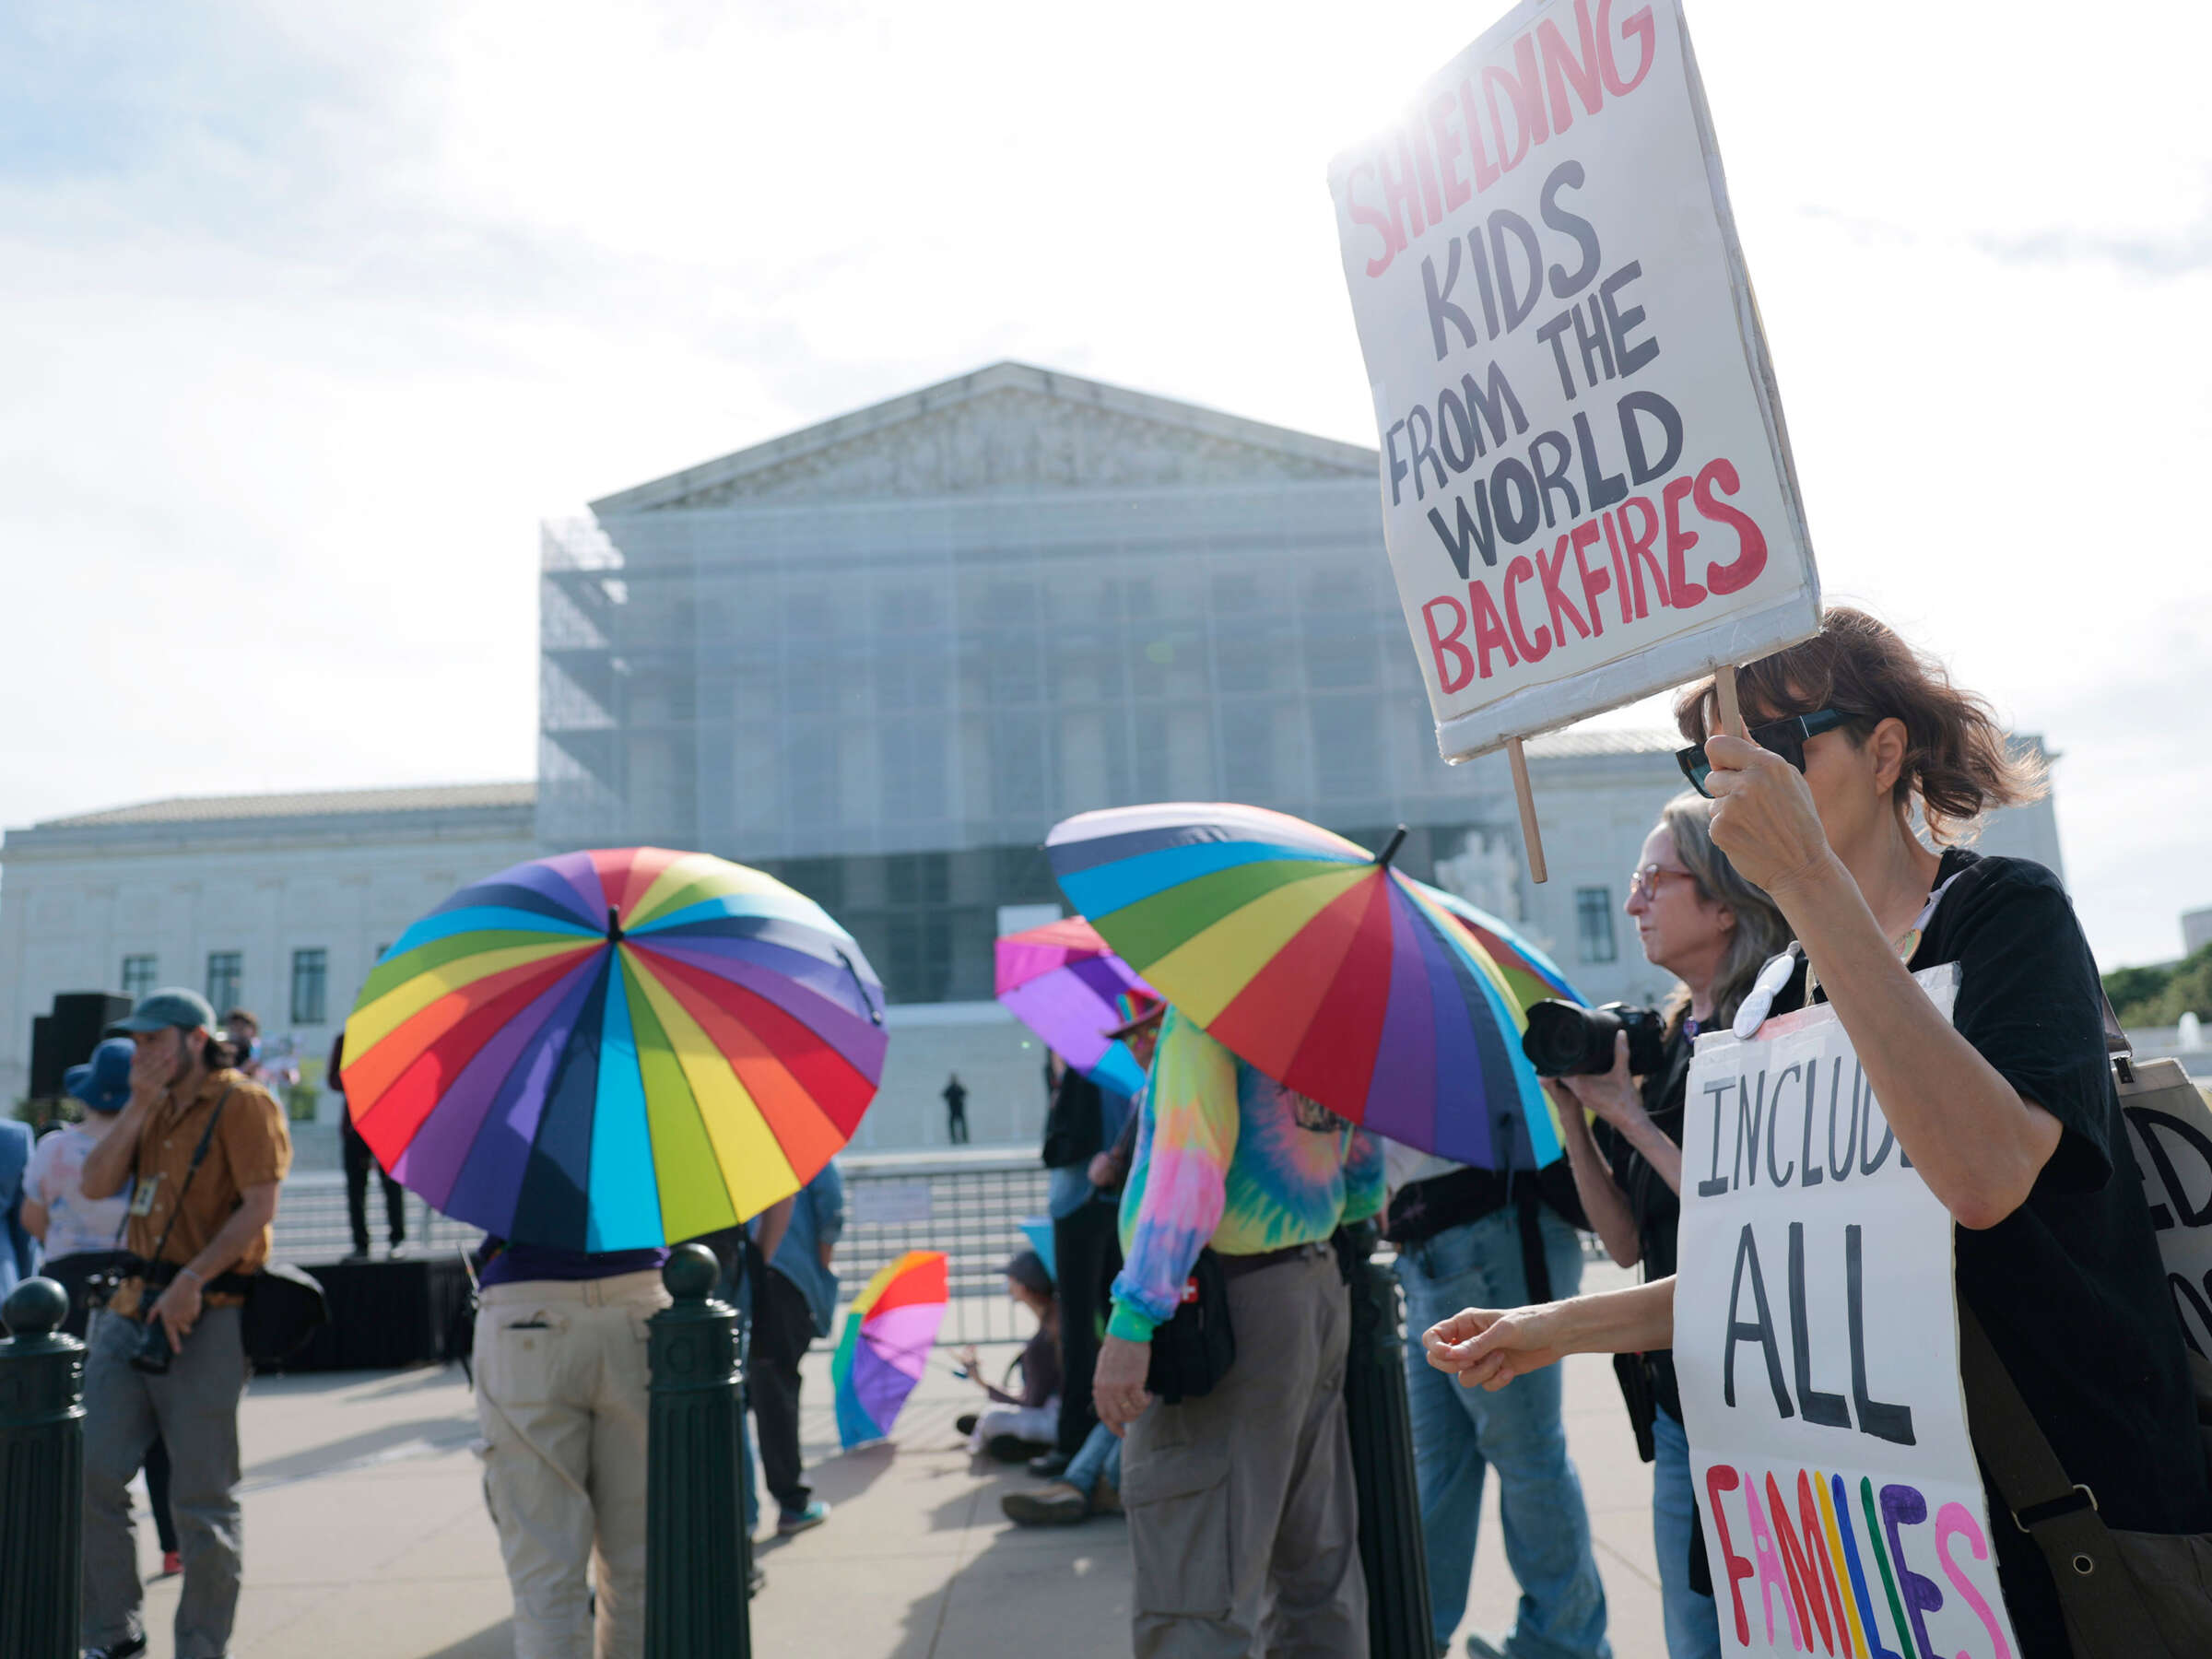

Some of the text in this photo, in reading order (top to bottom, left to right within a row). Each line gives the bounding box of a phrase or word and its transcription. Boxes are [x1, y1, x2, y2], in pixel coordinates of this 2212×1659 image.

[1347, 0, 1656, 278] SHIELDING
[1420, 159, 1602, 362] KIDS
[1385, 259, 1660, 507] FROM THE
[1427, 391, 1684, 581] WORLD
[1421, 458, 1769, 695] BACKFIRES
[1698, 1055, 1914, 1197] INCLUD
[1724, 1221, 1917, 1446] ALL
[1706, 1464, 2012, 1659] FAMILIES
